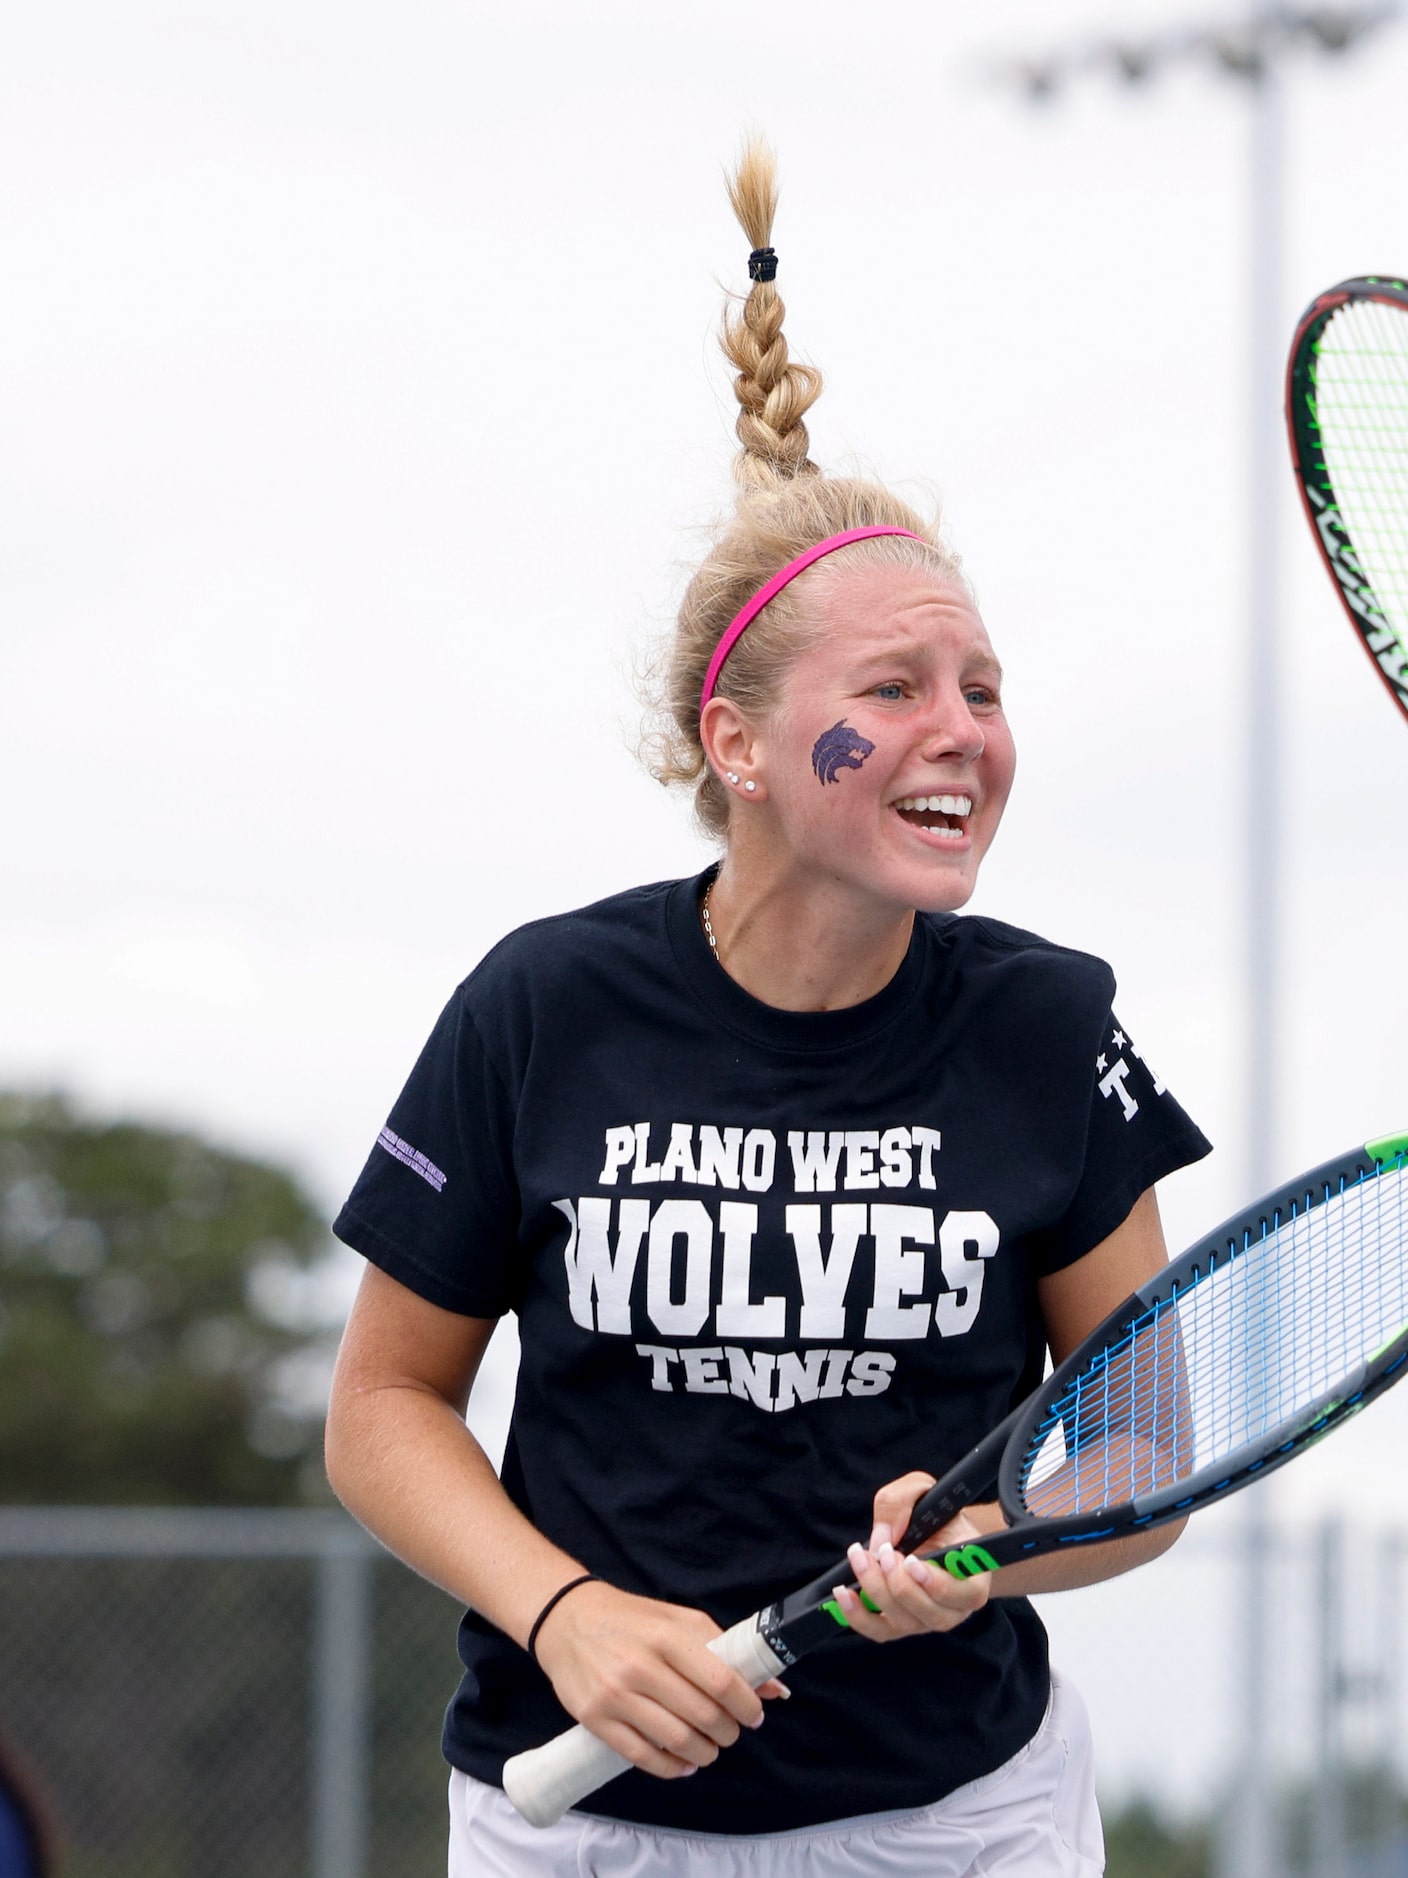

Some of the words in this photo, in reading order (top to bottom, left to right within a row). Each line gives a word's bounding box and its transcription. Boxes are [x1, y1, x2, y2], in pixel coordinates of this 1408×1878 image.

[599, 1122, 776, 1192] PLANO
[788, 1126, 941, 1192] WEST
[552, 1197, 999, 1339] WOLVES
[636, 1344, 896, 1412] TENNIS
